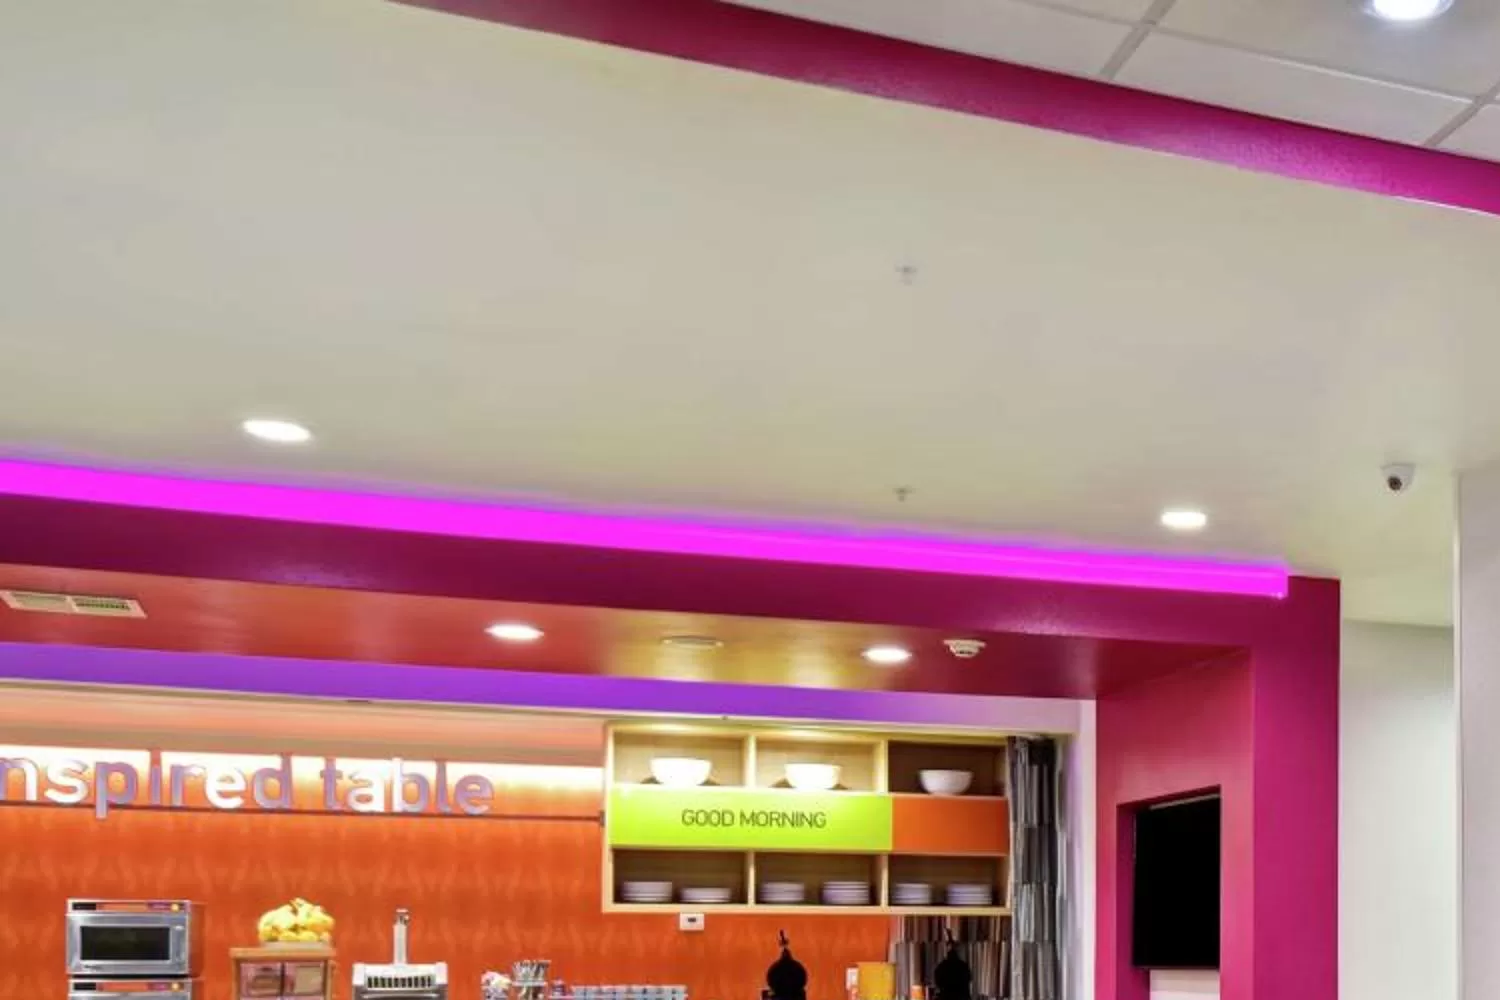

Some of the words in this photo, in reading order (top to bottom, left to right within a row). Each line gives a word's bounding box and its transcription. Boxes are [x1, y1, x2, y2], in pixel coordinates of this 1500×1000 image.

[319, 756, 494, 816] table
[681, 808, 735, 828] GOOD
[739, 810, 827, 829] MORNING
